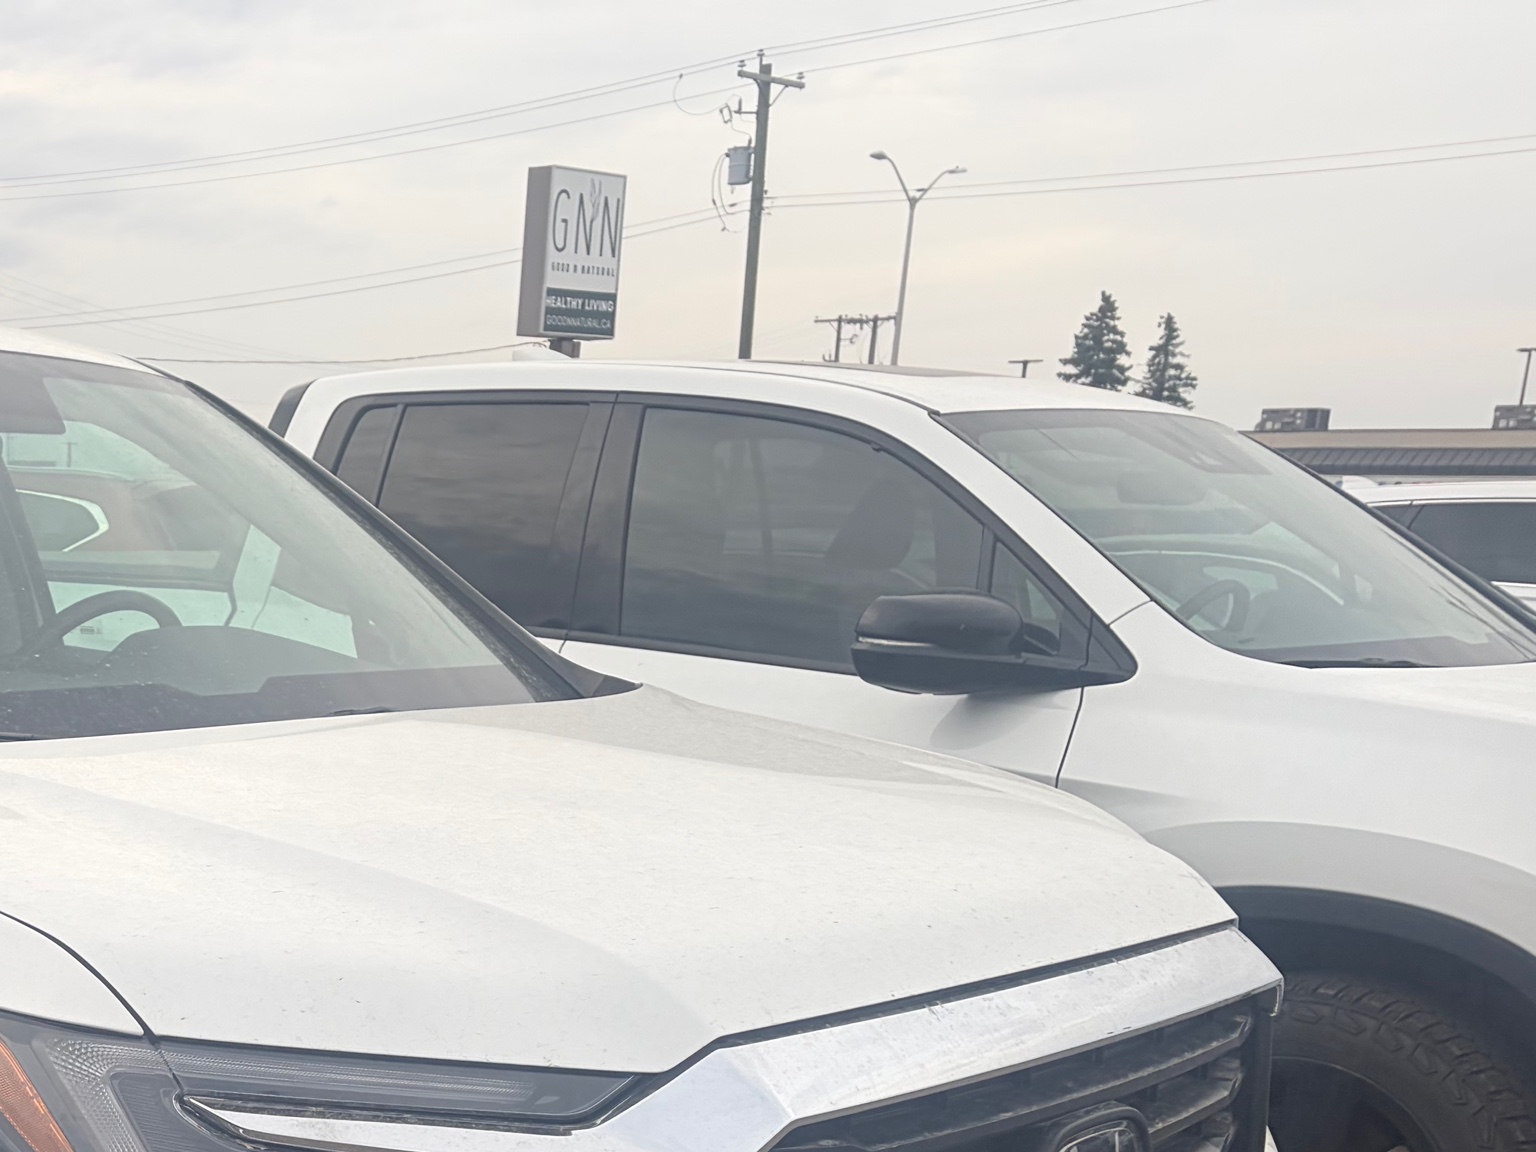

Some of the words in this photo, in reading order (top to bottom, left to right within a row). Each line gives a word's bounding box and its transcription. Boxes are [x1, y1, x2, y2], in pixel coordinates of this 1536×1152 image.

[552, 188, 621, 258] GNN
[545, 296, 584, 310] HEALTHY
[584, 298, 615, 312] LIVING
